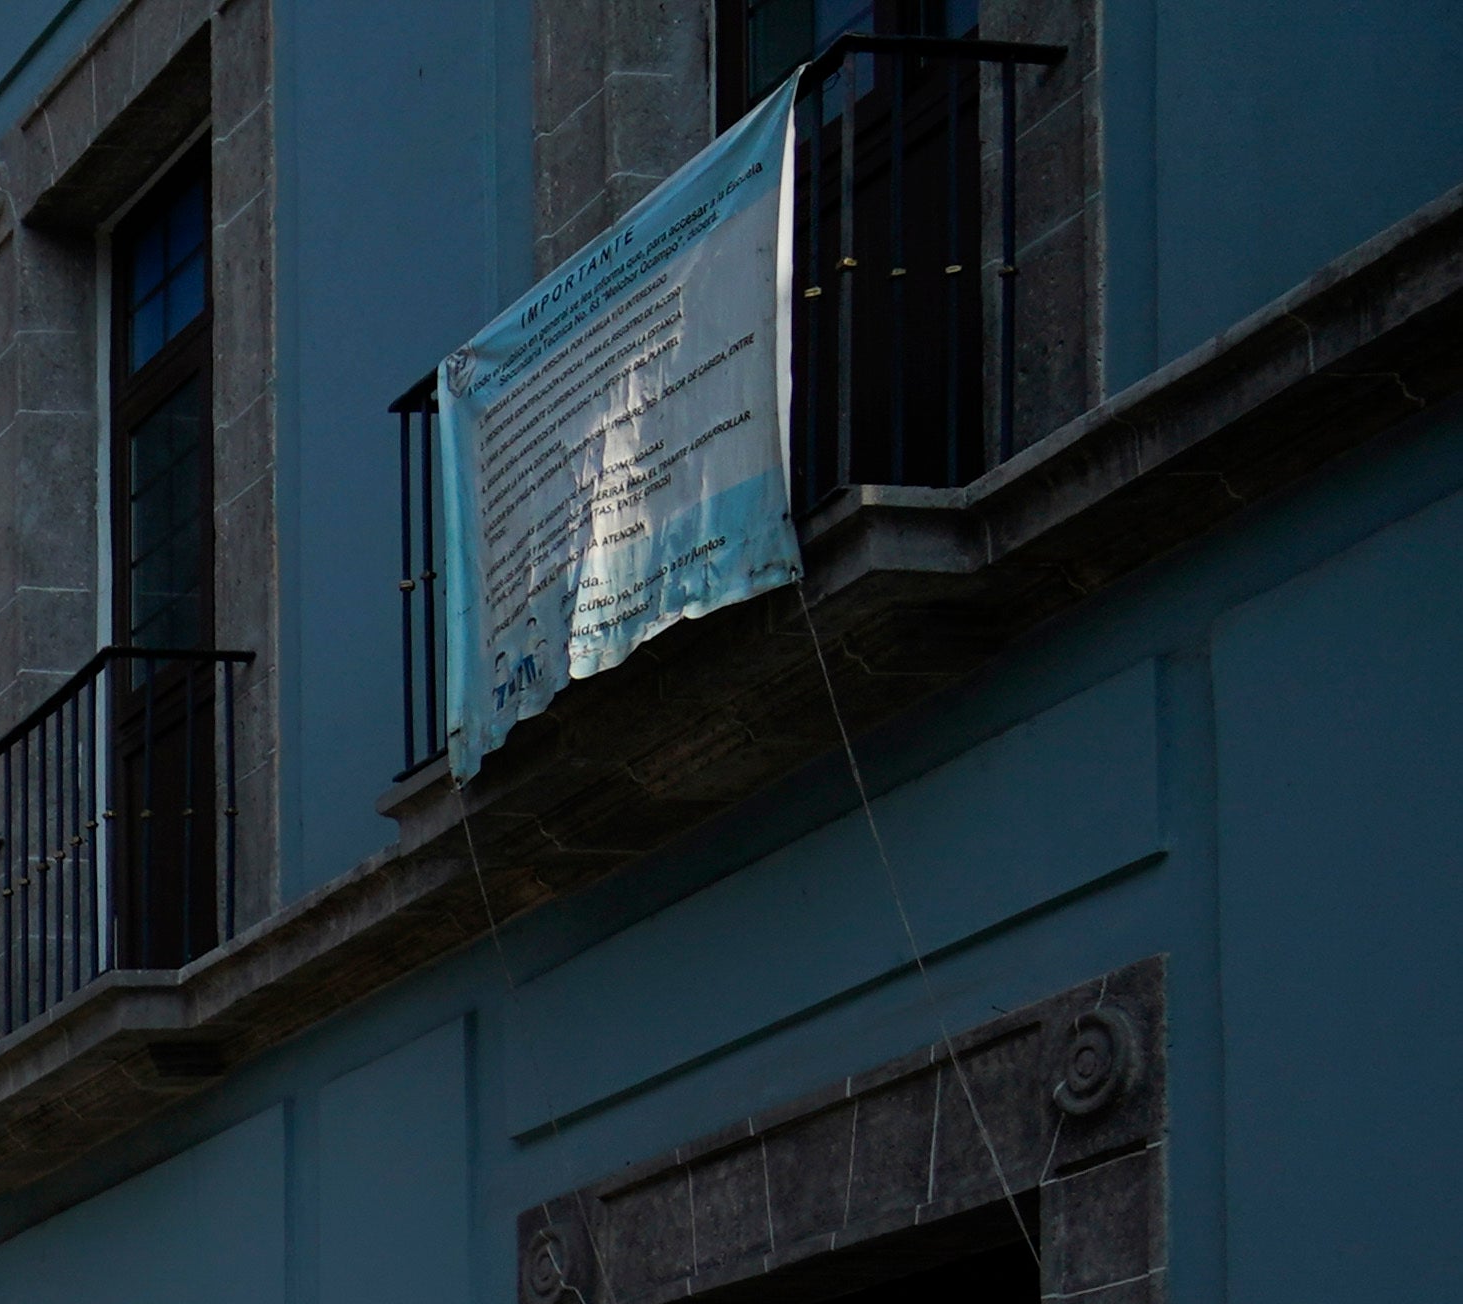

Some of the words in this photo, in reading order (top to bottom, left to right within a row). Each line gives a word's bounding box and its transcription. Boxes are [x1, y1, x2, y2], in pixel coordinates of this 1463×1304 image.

[519, 227, 635, 327] IMPORTANTE
[538, 307, 569, 340] general
[593, 263, 625, 294] informa
[645, 231, 667, 255] para
[667, 203, 708, 236] accesar
